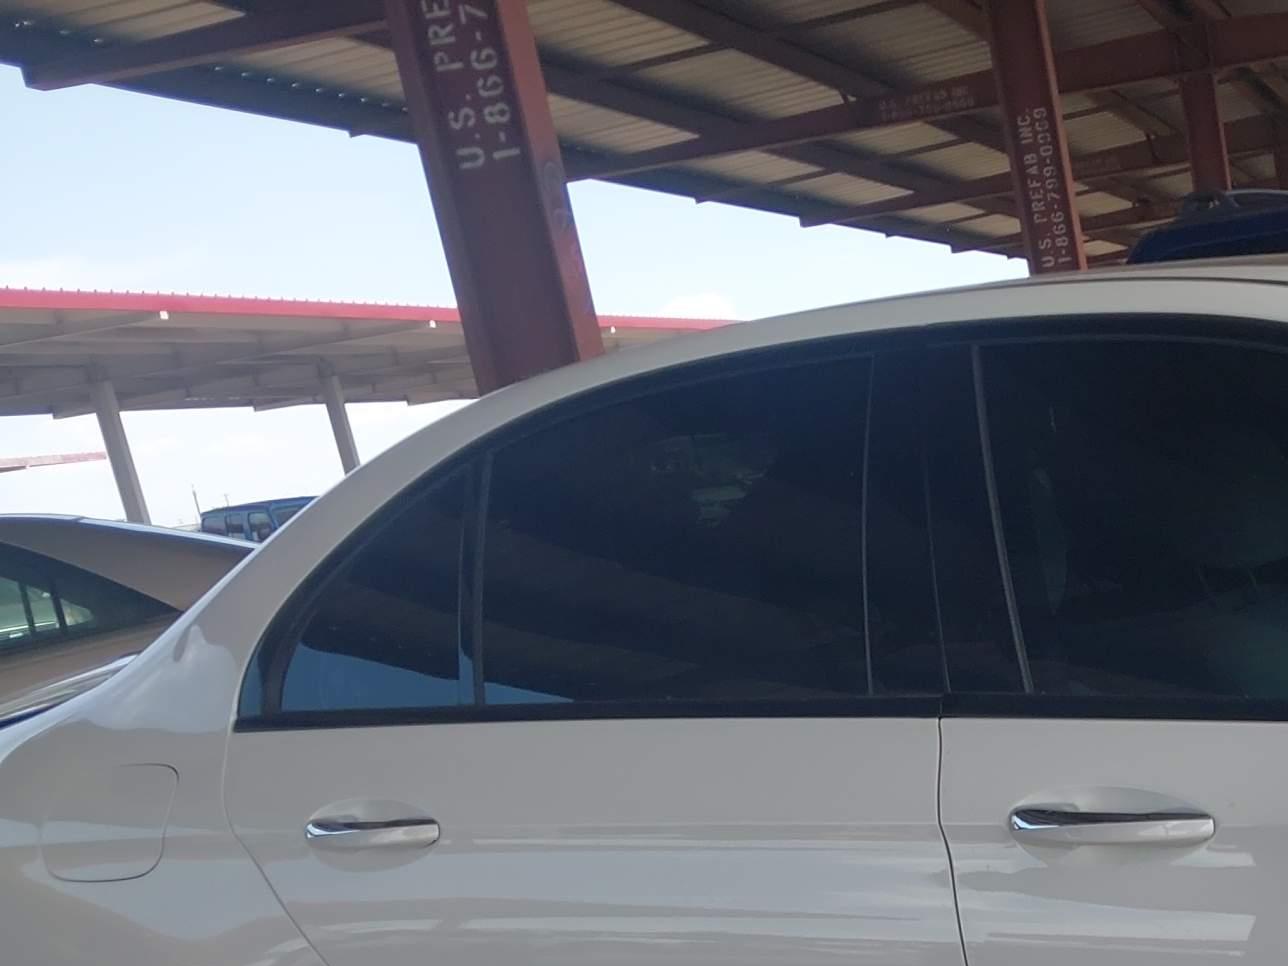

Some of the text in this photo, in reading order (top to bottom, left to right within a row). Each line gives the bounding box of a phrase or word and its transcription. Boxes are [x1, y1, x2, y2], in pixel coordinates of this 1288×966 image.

[458, 5, 521, 160] 1-866-7
[448, 93, 486, 169] U.S.
[1024, 154, 1047, 223] PREFAB
[1038, 233, 1055, 267] U.S.
